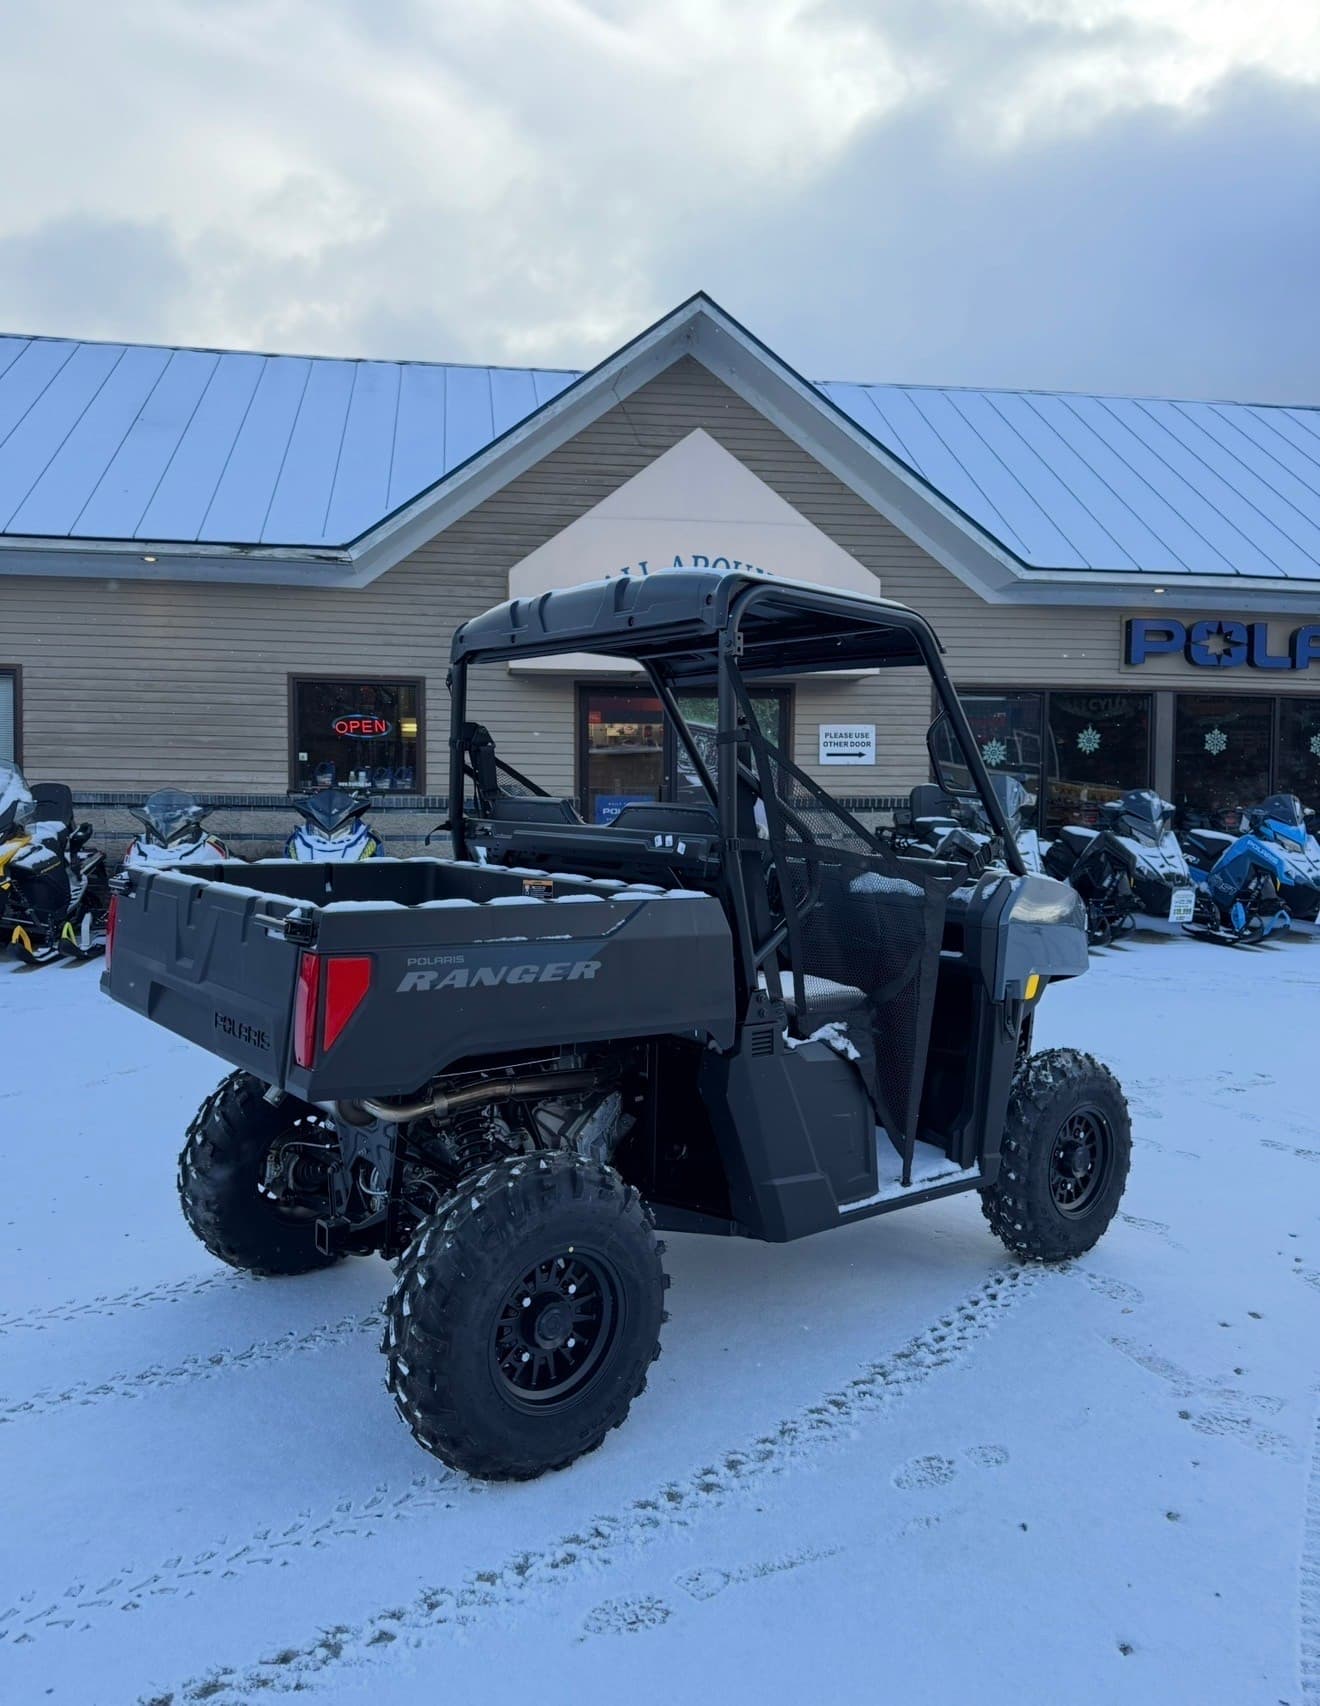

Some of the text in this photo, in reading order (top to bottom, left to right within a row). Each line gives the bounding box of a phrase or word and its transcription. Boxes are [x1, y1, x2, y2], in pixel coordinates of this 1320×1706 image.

[335, 719, 386, 734] OPEN
[407, 955, 464, 967] POLARIS
[396, 960, 602, 993] RANGER
[214, 1012, 271, 1052] POLARIS
